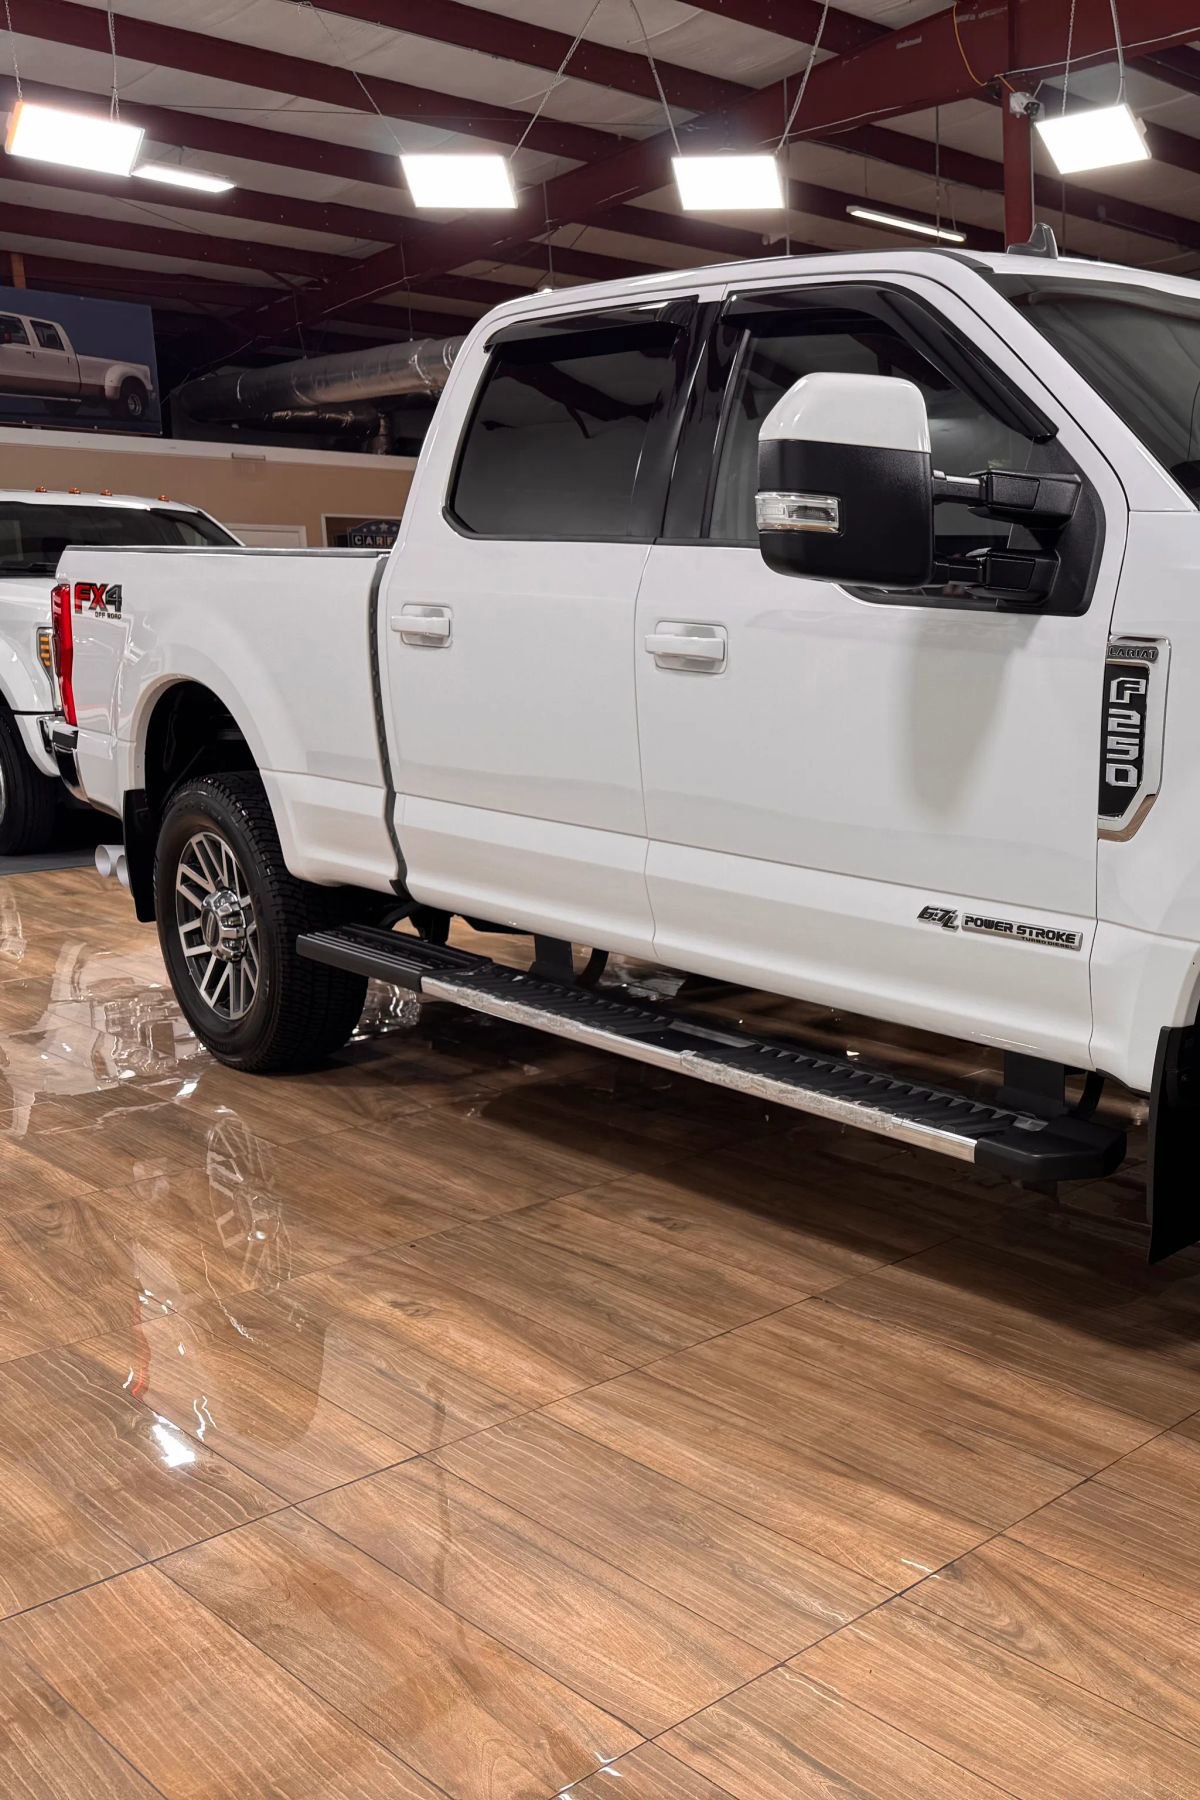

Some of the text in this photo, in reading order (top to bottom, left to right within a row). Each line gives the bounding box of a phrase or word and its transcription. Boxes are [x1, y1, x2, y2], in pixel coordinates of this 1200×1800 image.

[74, 581, 123, 615] FX4
[94, 611, 122, 620] OFF ROAD
[1108, 646, 1158, 660] LARIAT
[964, 915, 1014, 934] POWER
[1016, 924, 1077, 945] STROKE
[1020, 936, 1076, 950] TURBO DIESEL
